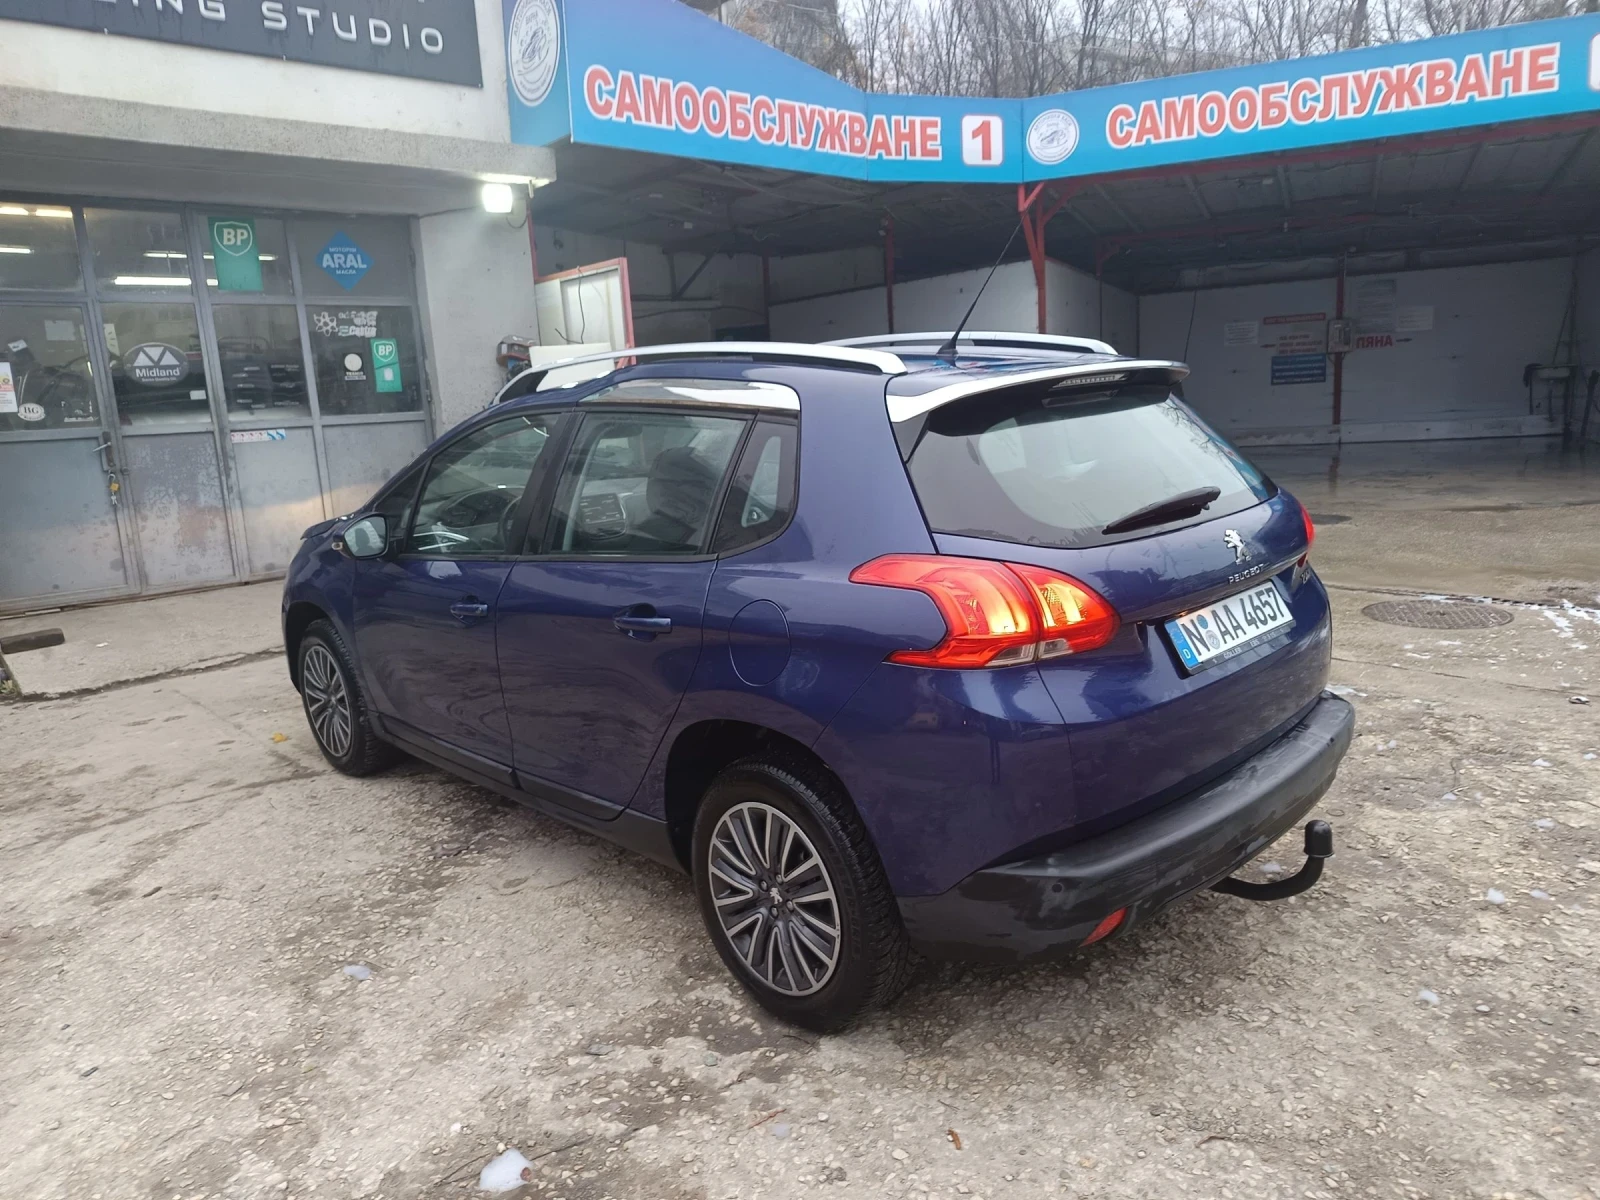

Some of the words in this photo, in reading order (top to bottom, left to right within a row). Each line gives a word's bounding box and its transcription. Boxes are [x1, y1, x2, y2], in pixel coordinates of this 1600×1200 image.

[261, 1, 443, 54] STUDIO
[1106, 42, 1561, 149] САМООБСЛУЖВАНЕ
[584, 65, 942, 161] САМООБСЛУЖВАНЕ
[971, 120, 992, 161] 1
[222, 228, 248, 246] BP
[322, 253, 367, 269] ARAL
[378, 345, 392, 355] BP
[1357, 335, 1393, 348] ПЯНА
[135, 367, 180, 377] Midland
[1228, 564, 1264, 584] PEUGEOT
[1181, 619, 1210, 656] N
[1211, 604, 1246, 644] AA
[1239, 587, 1284, 630] 4657
[1183, 648, 1191, 659] D
